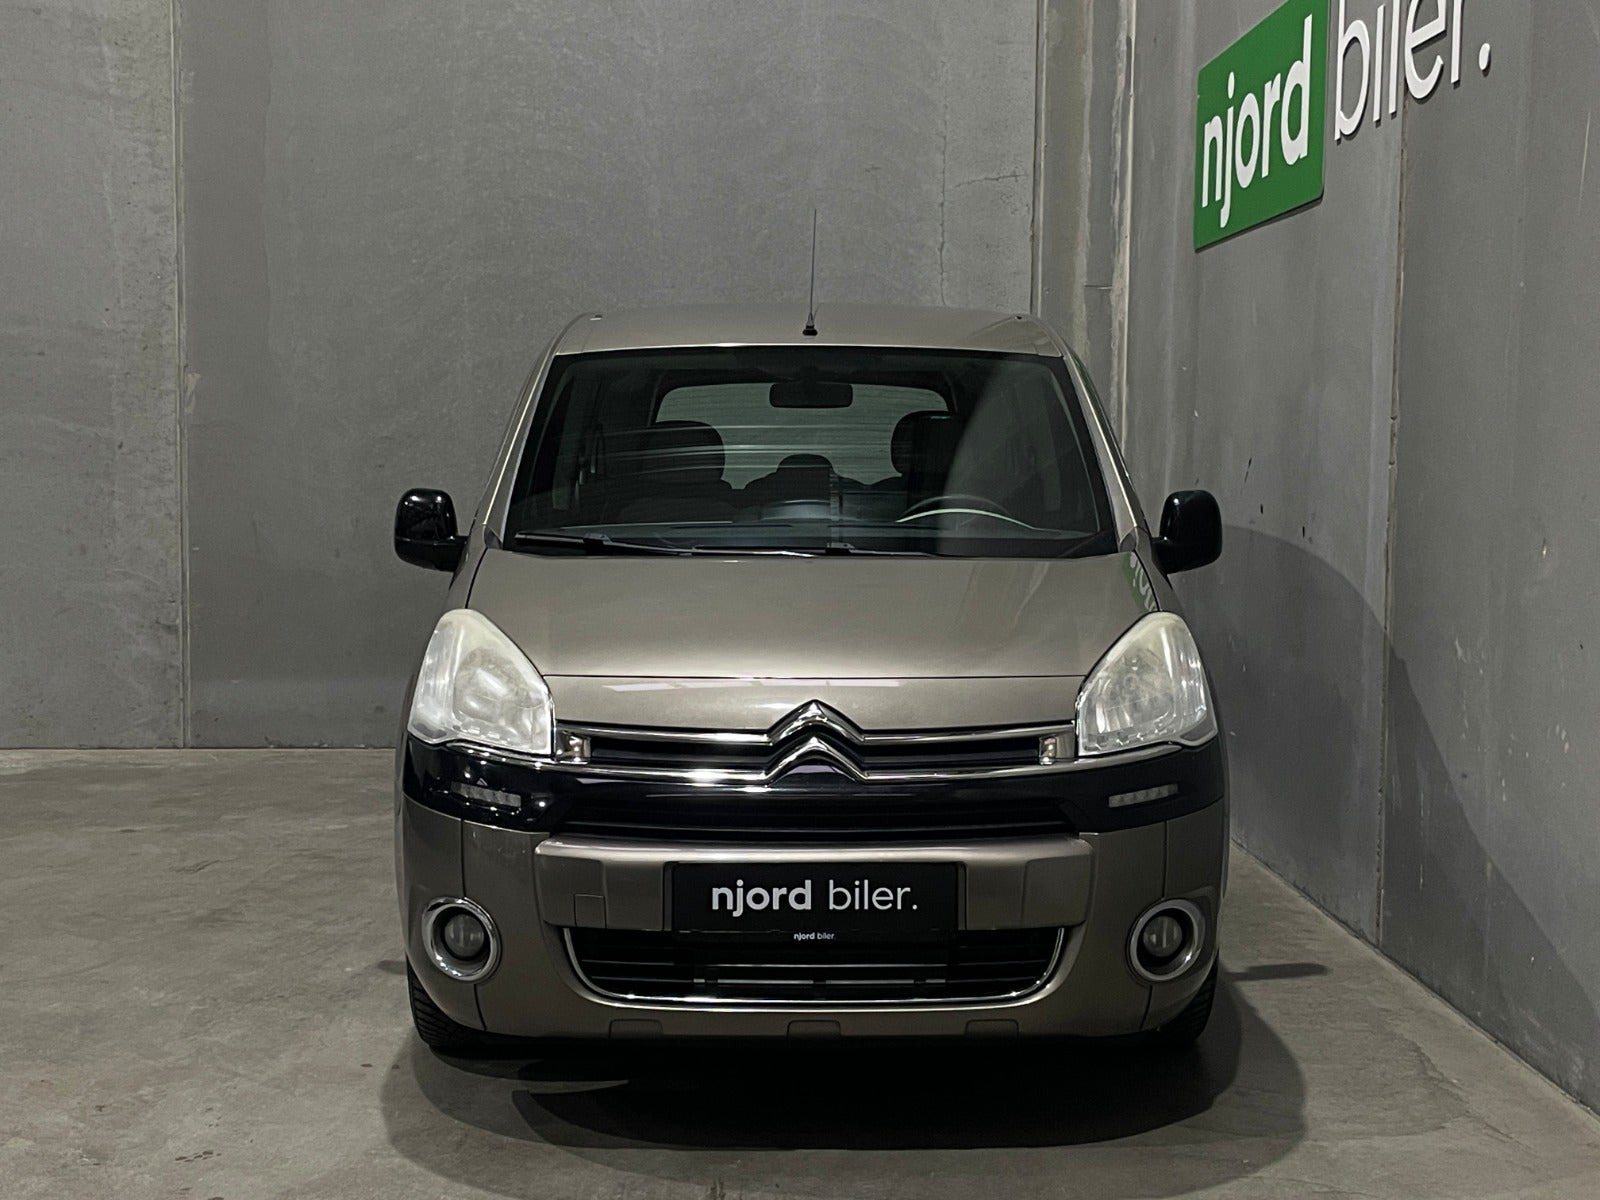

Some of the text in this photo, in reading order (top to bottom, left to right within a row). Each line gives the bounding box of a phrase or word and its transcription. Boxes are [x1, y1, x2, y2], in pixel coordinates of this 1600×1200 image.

[1201, 13, 1313, 228] njord
[712, 879, 918, 917] njord biler.
[793, 931, 816, 941] njord
